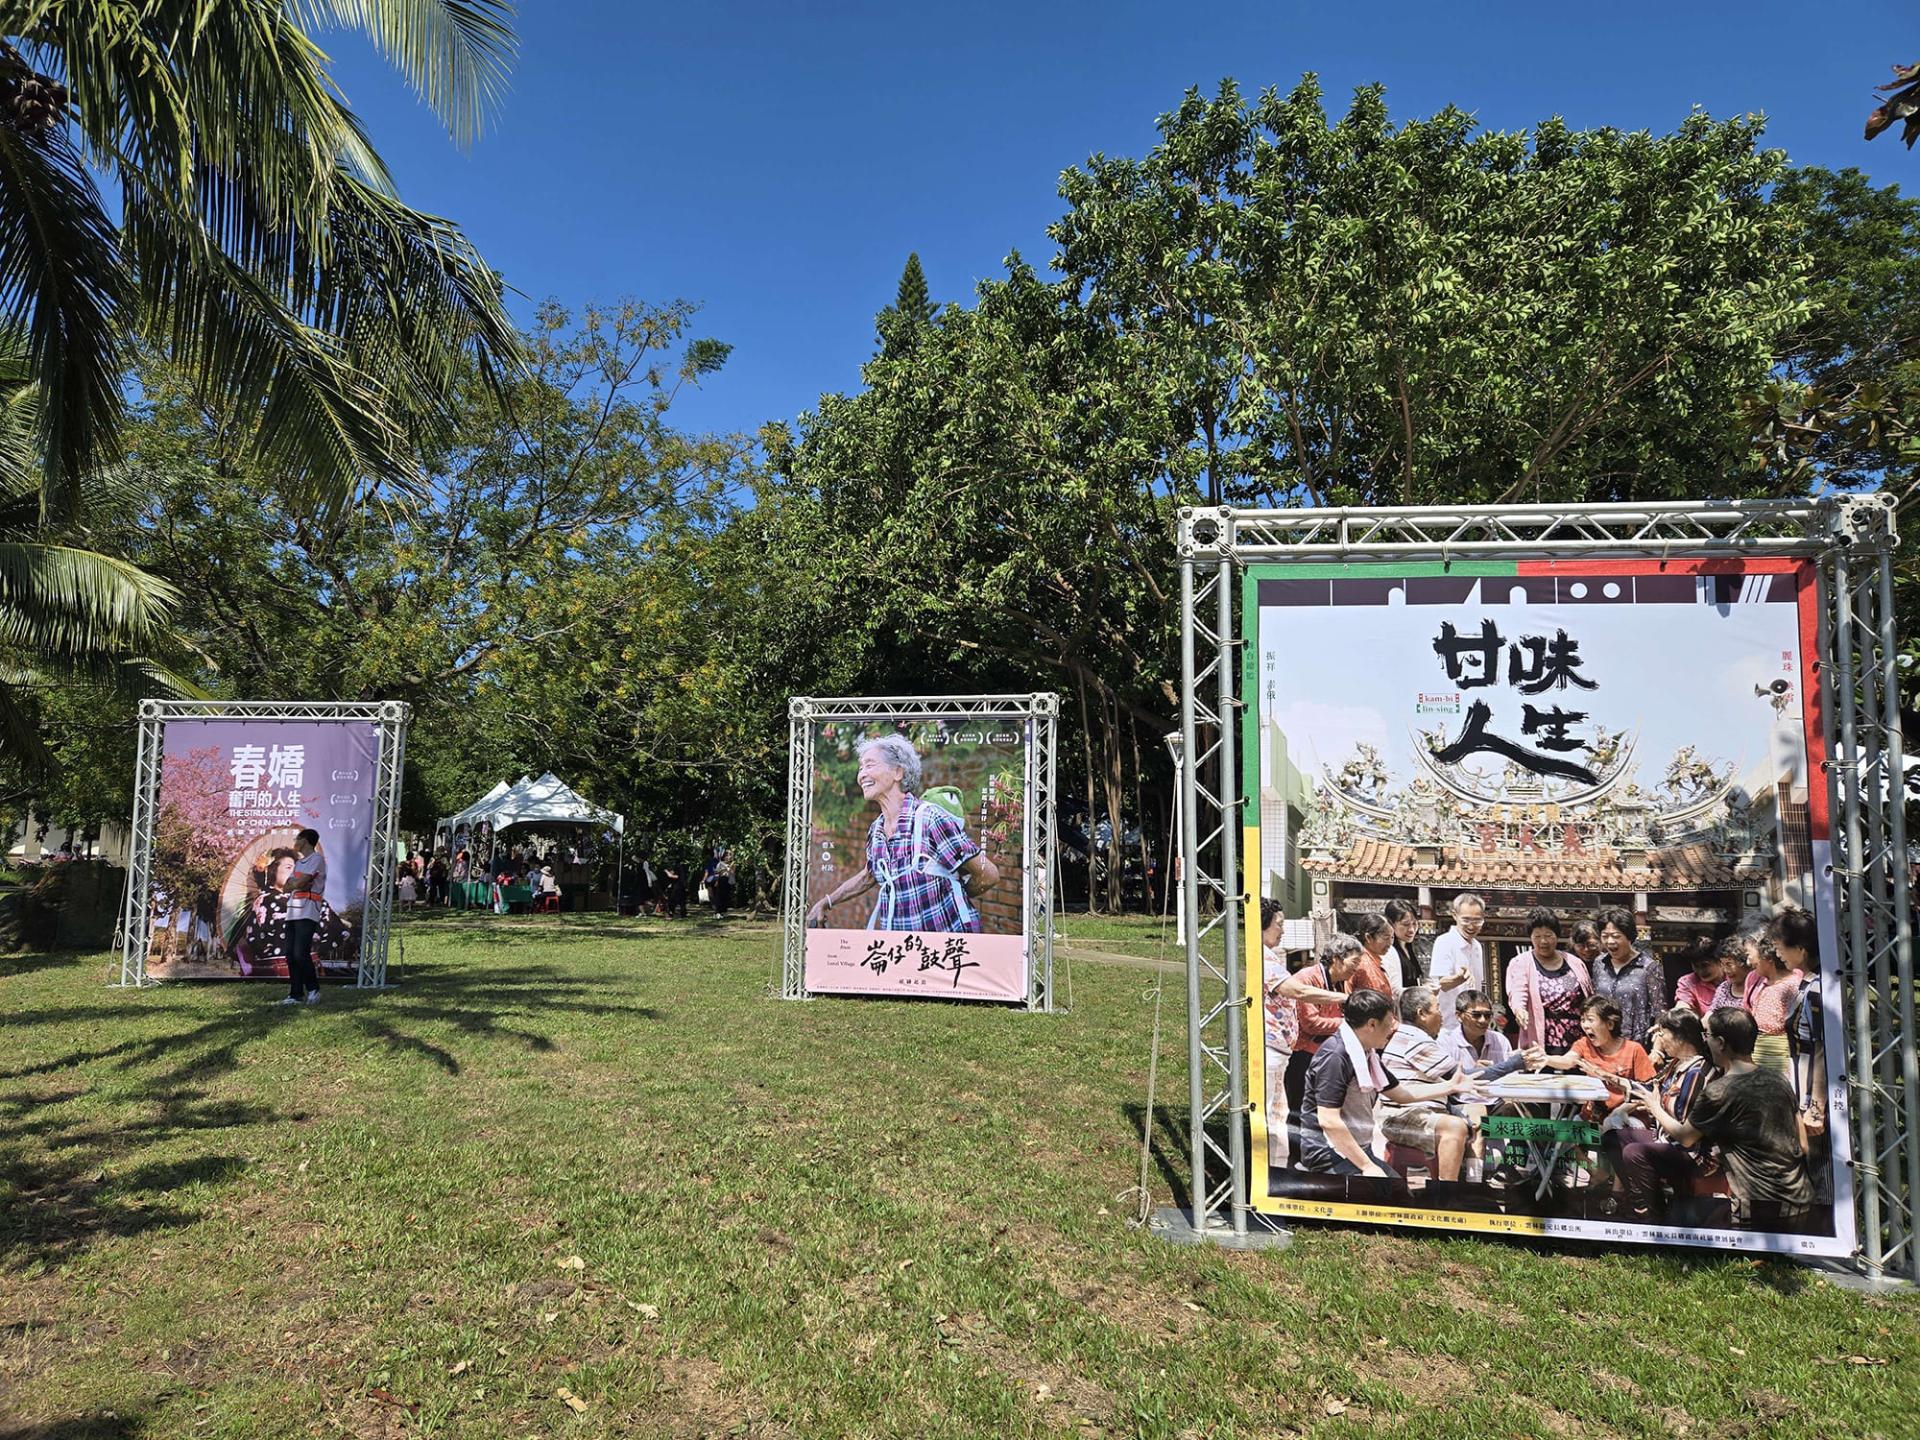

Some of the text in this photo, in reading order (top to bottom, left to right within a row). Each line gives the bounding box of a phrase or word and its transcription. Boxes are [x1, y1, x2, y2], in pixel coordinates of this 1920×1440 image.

[1432, 617, 1600, 695] 甘味
[1428, 698, 1600, 786] 人生
[229, 790, 301, 808] 奮鬥的人生
[229, 809, 301, 817] THE STRUGGLE LIFE
[860, 934, 980, 989] 崙仔的鼓聲
[1496, 1121, 1588, 1140] 來我家喝一杯
